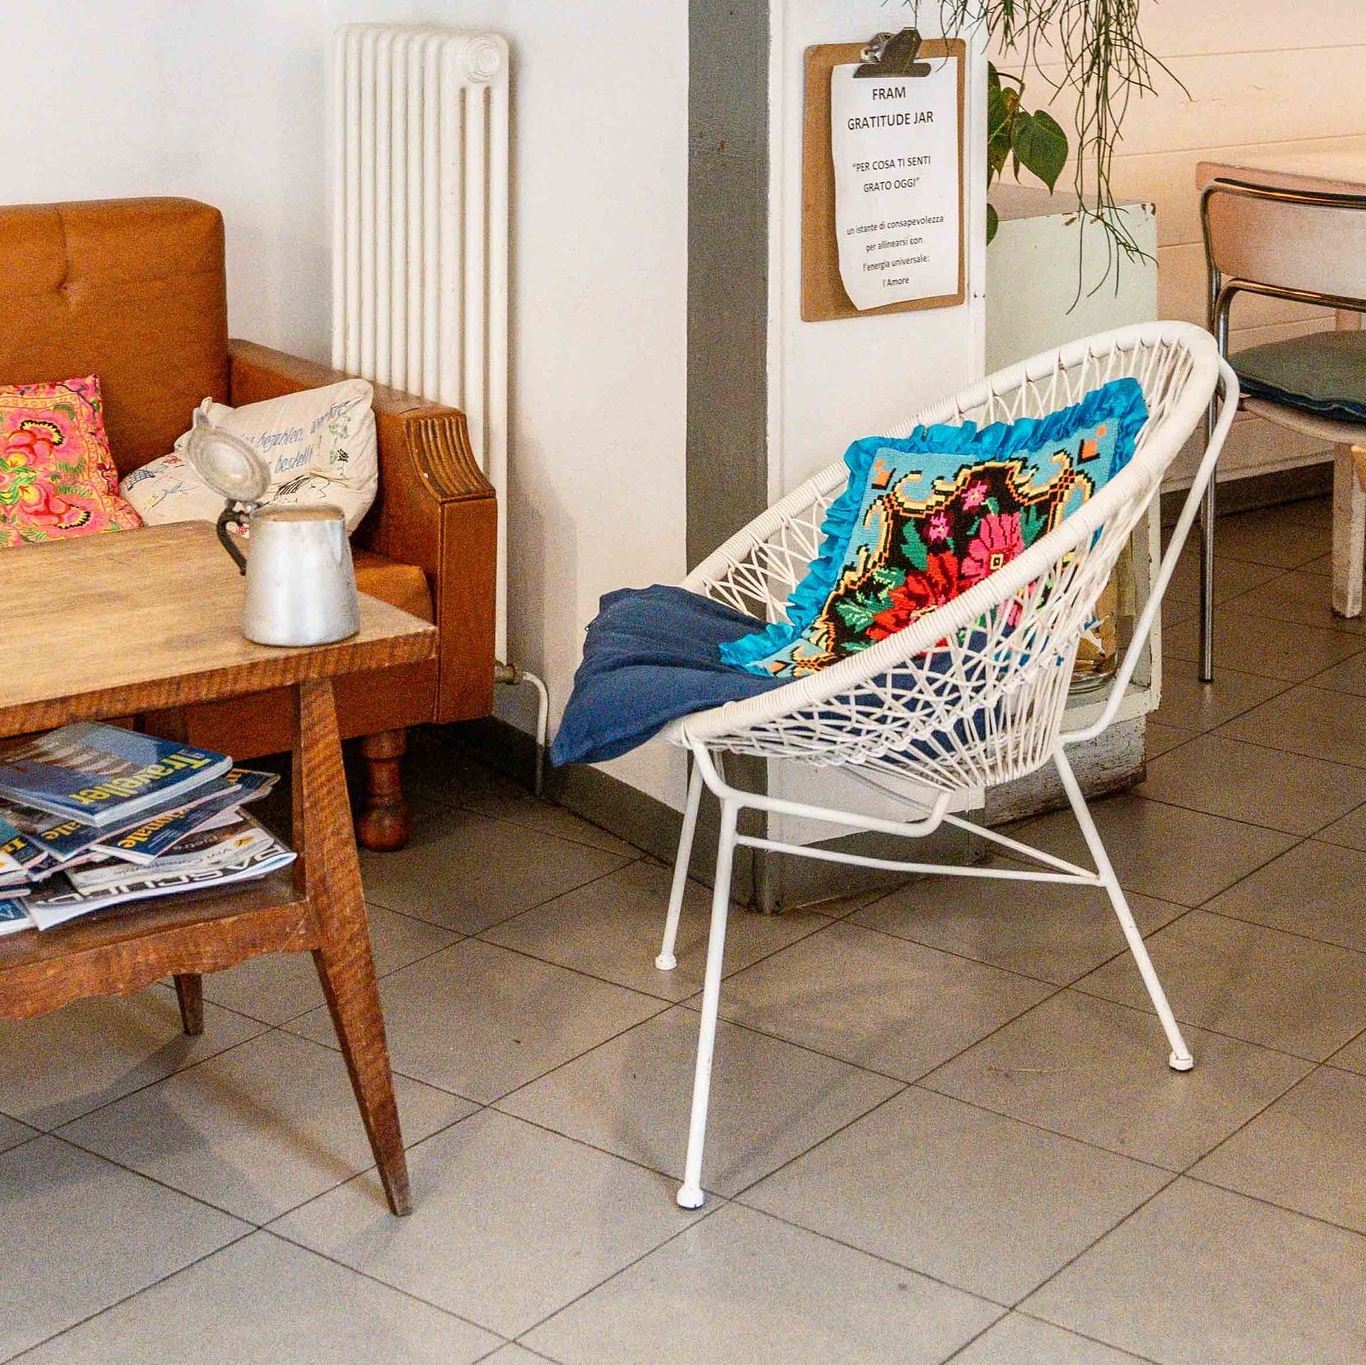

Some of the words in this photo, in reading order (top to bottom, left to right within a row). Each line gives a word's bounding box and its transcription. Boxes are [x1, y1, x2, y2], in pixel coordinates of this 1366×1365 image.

[871, 86, 906, 101] FRAM
[847, 112, 911, 131] GRATITUDE
[913, 110, 934, 125] JAR
[872, 158, 896, 170] COSA
[898, 157, 906, 168] TI
[907, 155, 931, 167] SENTI
[863, 181, 892, 193] GRATO
[847, 226, 856, 235] un
[856, 222, 878, 234] istante
[879, 220, 886, 231] di
[887, 215, 945, 232] consapevolezza
[866, 243, 876, 253] per
[877, 237, 909, 252] allinearsi
[910, 236, 923, 245] con
[891, 253, 930, 268] universale:
[69, 753, 212, 805] Traveller
